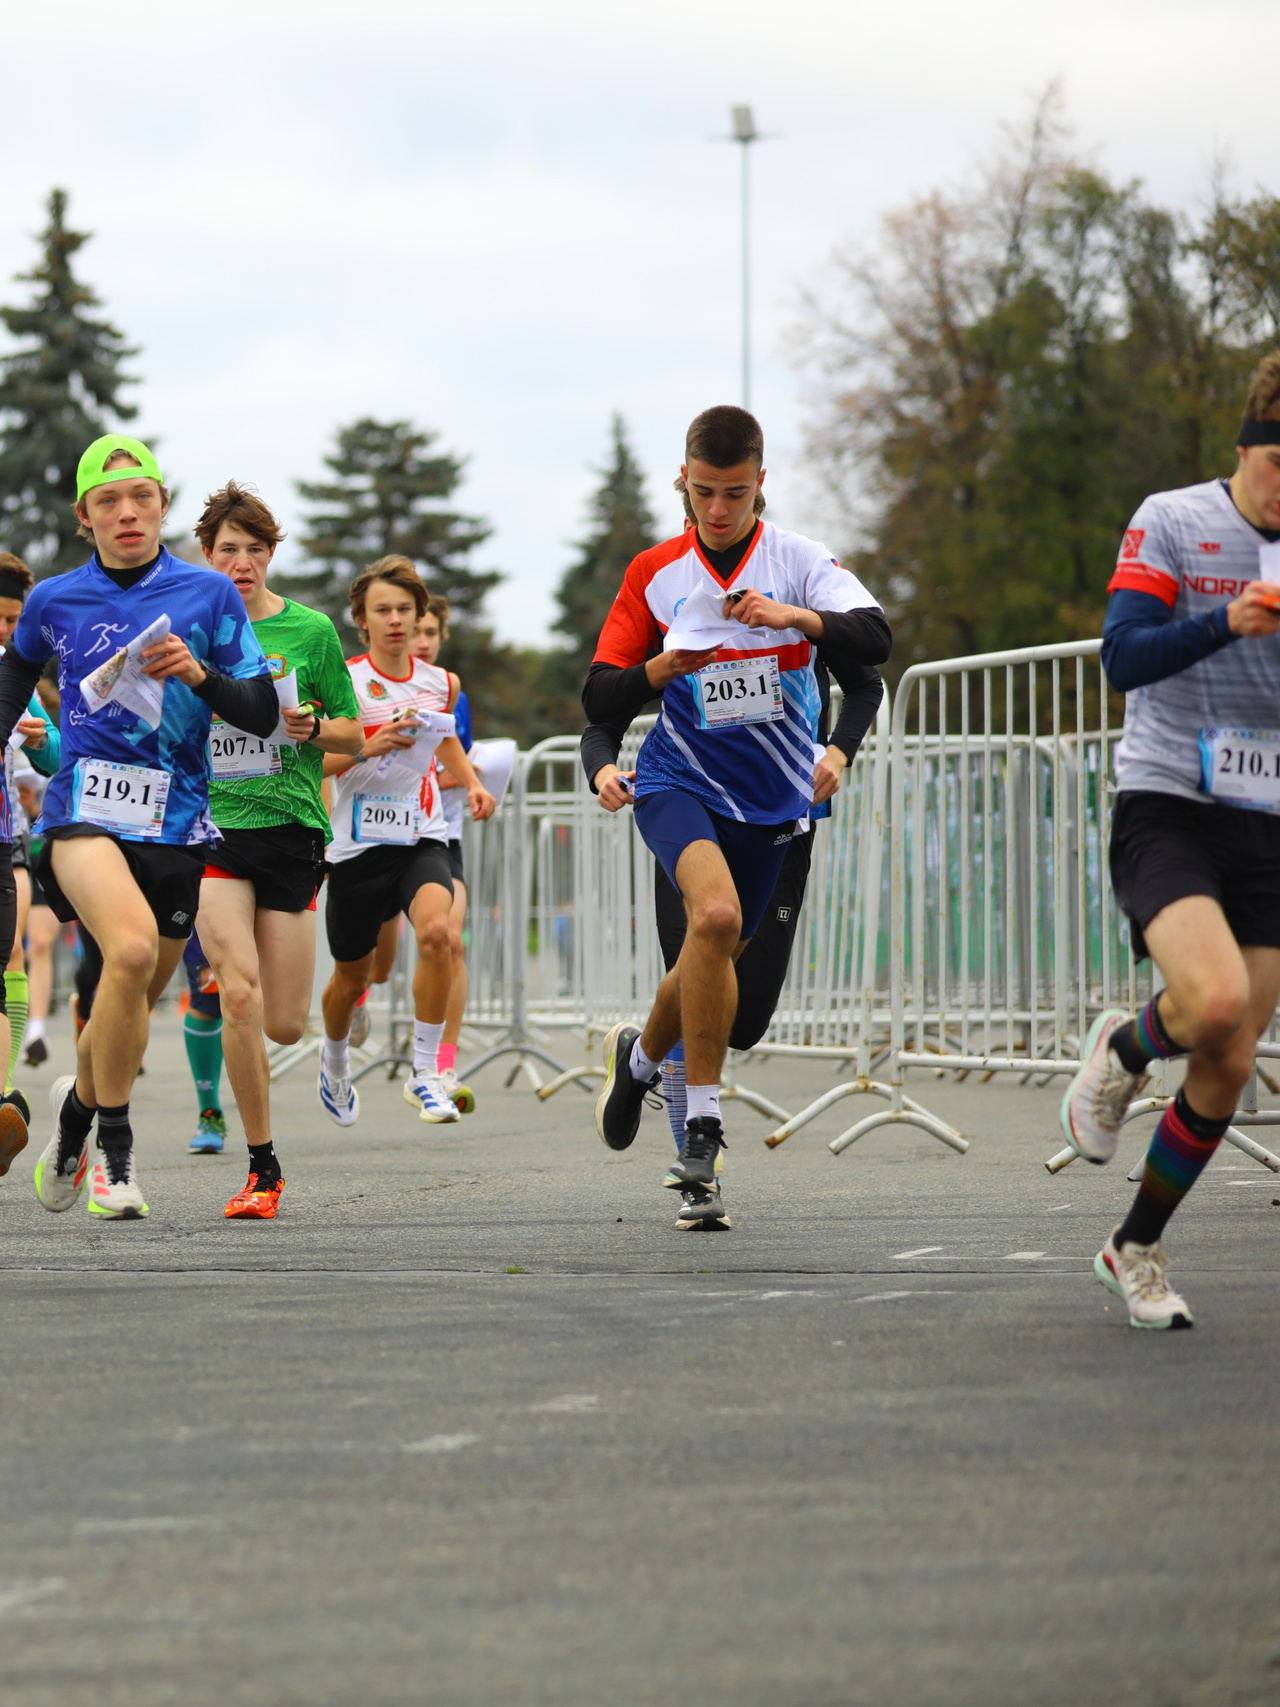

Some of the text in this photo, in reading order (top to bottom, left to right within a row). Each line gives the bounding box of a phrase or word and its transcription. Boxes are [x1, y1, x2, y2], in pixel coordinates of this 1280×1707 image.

[704, 674, 768, 703] 203.1
[212, 736, 266, 757] 207.1
[1220, 747, 1280, 778] 210.1
[84, 774, 151, 806] 219.1
[363, 807, 410, 826] 209.1
